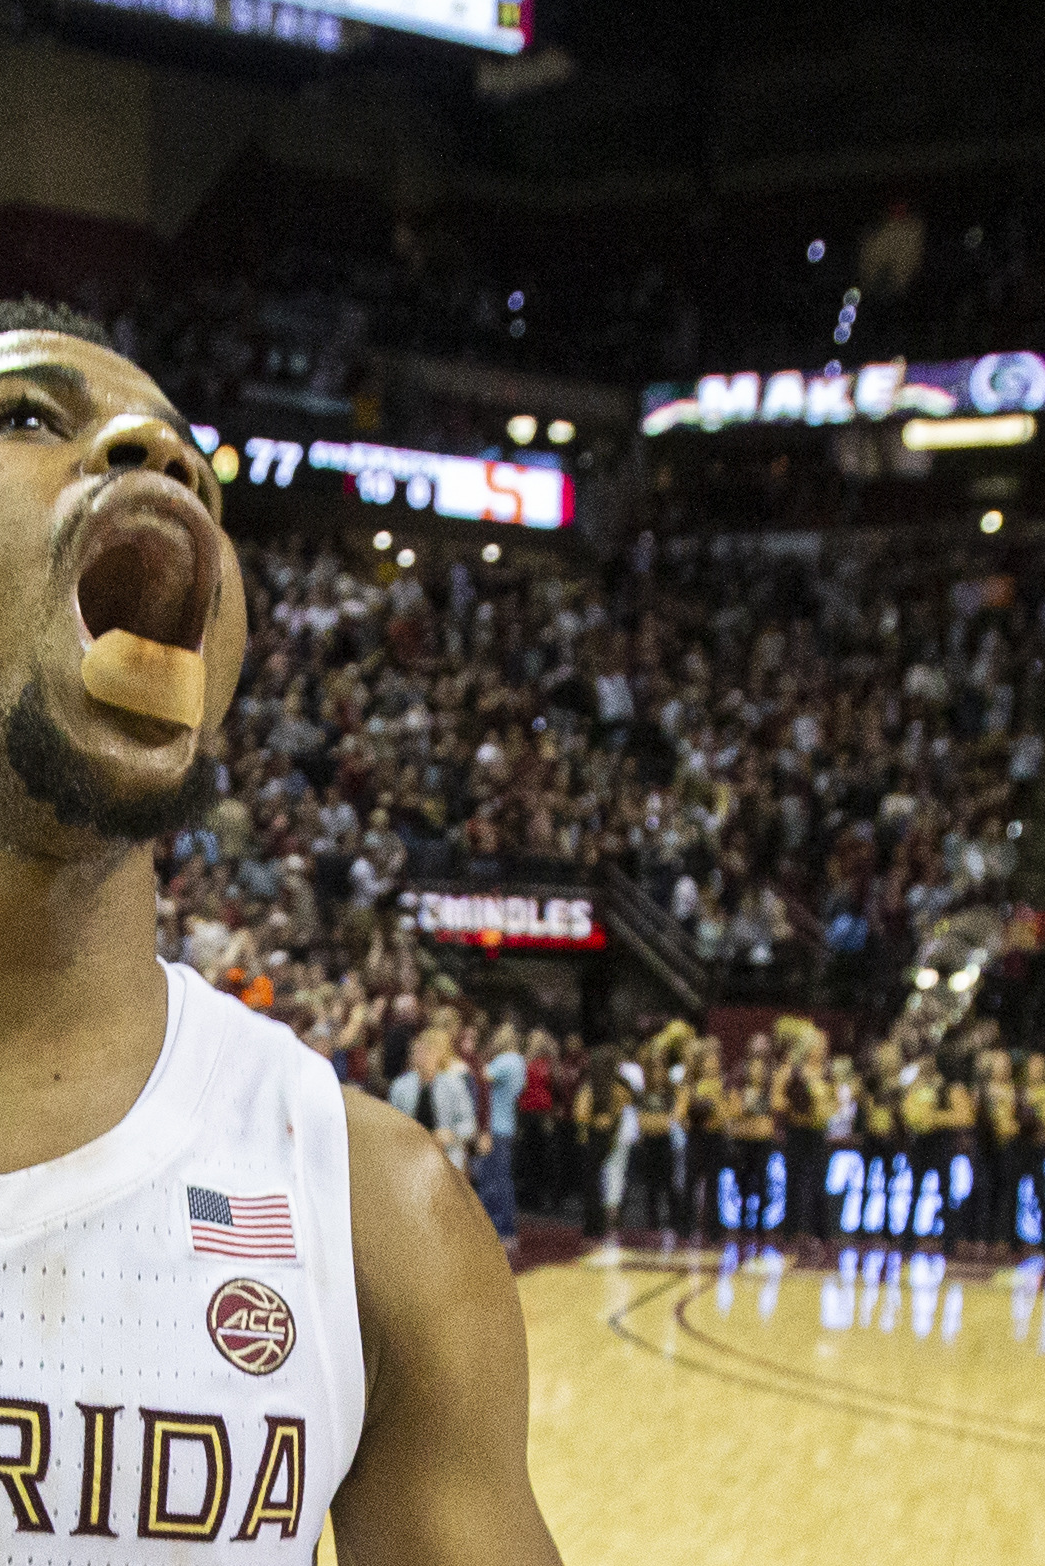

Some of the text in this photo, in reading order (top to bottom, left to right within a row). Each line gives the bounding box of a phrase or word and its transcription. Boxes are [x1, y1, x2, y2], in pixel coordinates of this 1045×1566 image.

[698, 362, 902, 428] MAKE
[245, 437, 304, 488] 77
[223, 1307, 287, 1334] ACC
